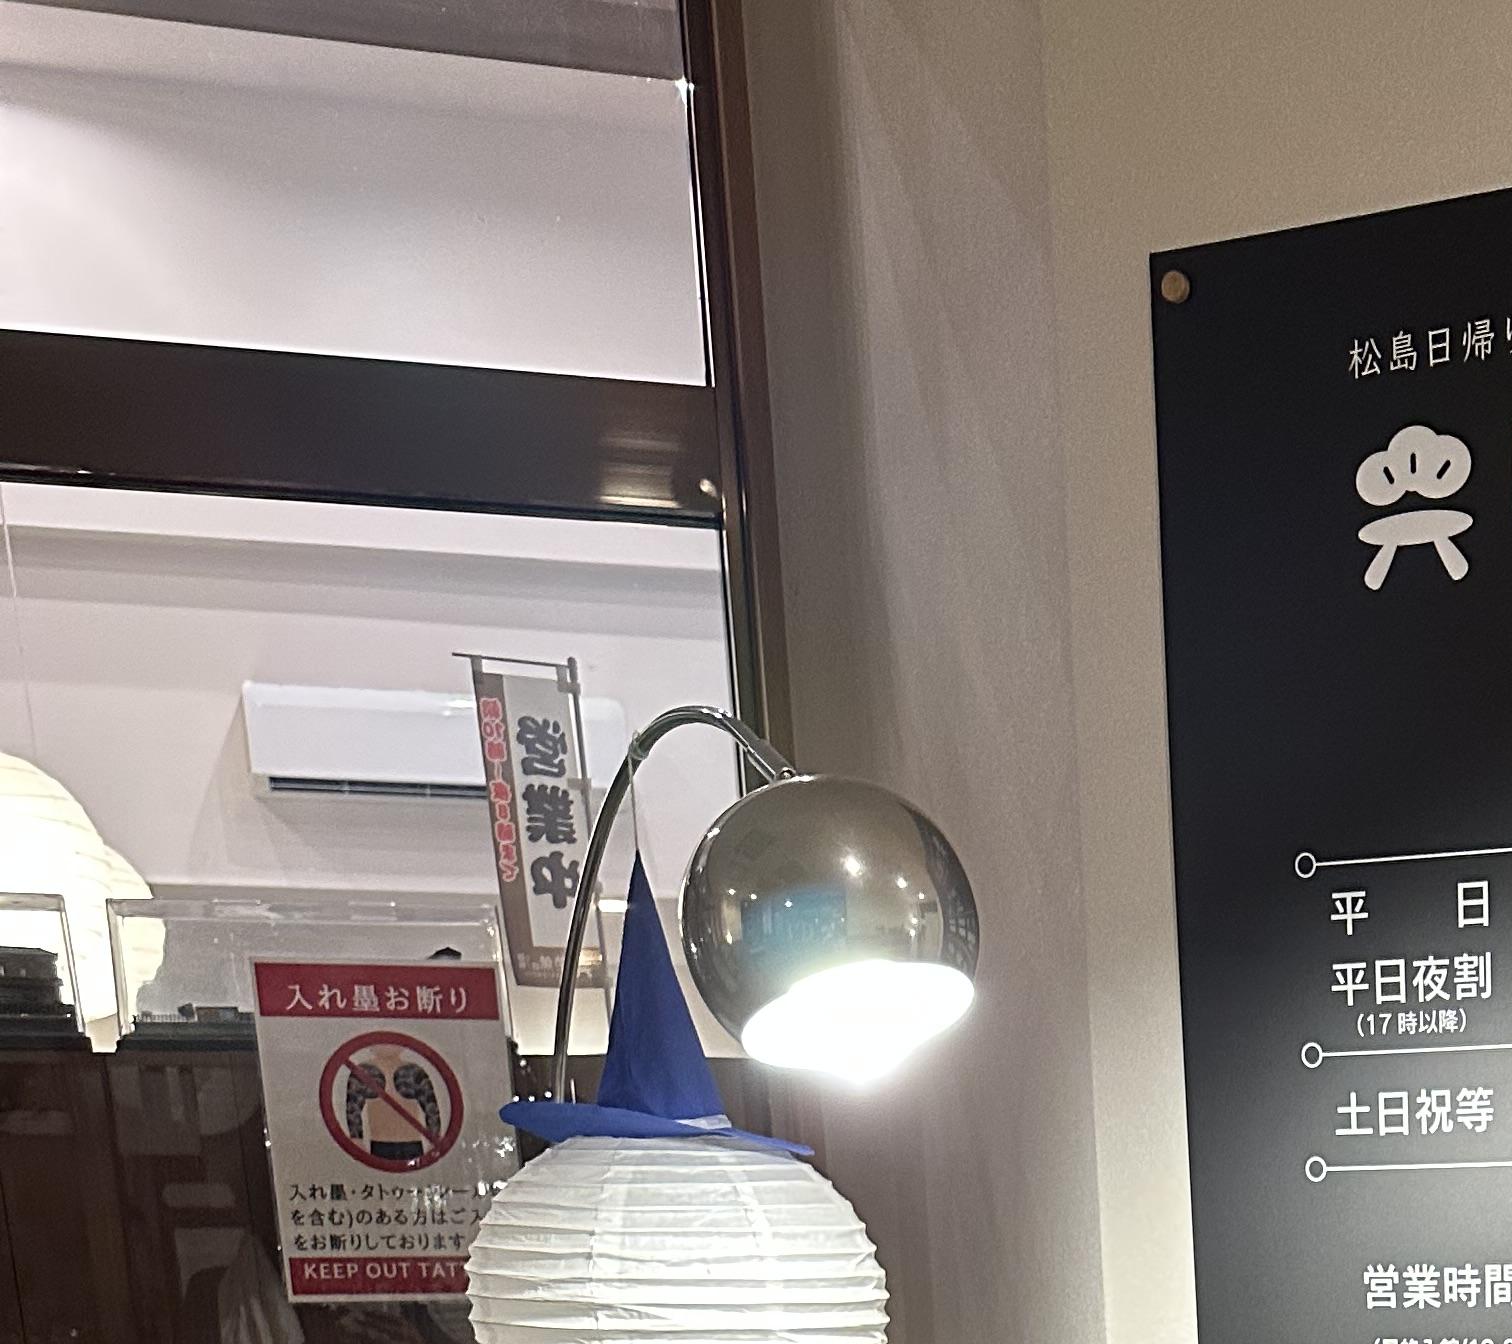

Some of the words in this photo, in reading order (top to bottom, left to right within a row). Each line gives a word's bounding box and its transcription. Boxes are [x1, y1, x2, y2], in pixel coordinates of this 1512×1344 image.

[1331, 952, 1493, 1005] 平日夜割
[286, 984, 467, 1013] 入れ墨お断り
[1335, 1088, 1494, 1136] 土日祝等
[304, 1264, 358, 1279] KEEP
[366, 1263, 411, 1279] OUT
[420, 1263, 466, 1278] TAT
